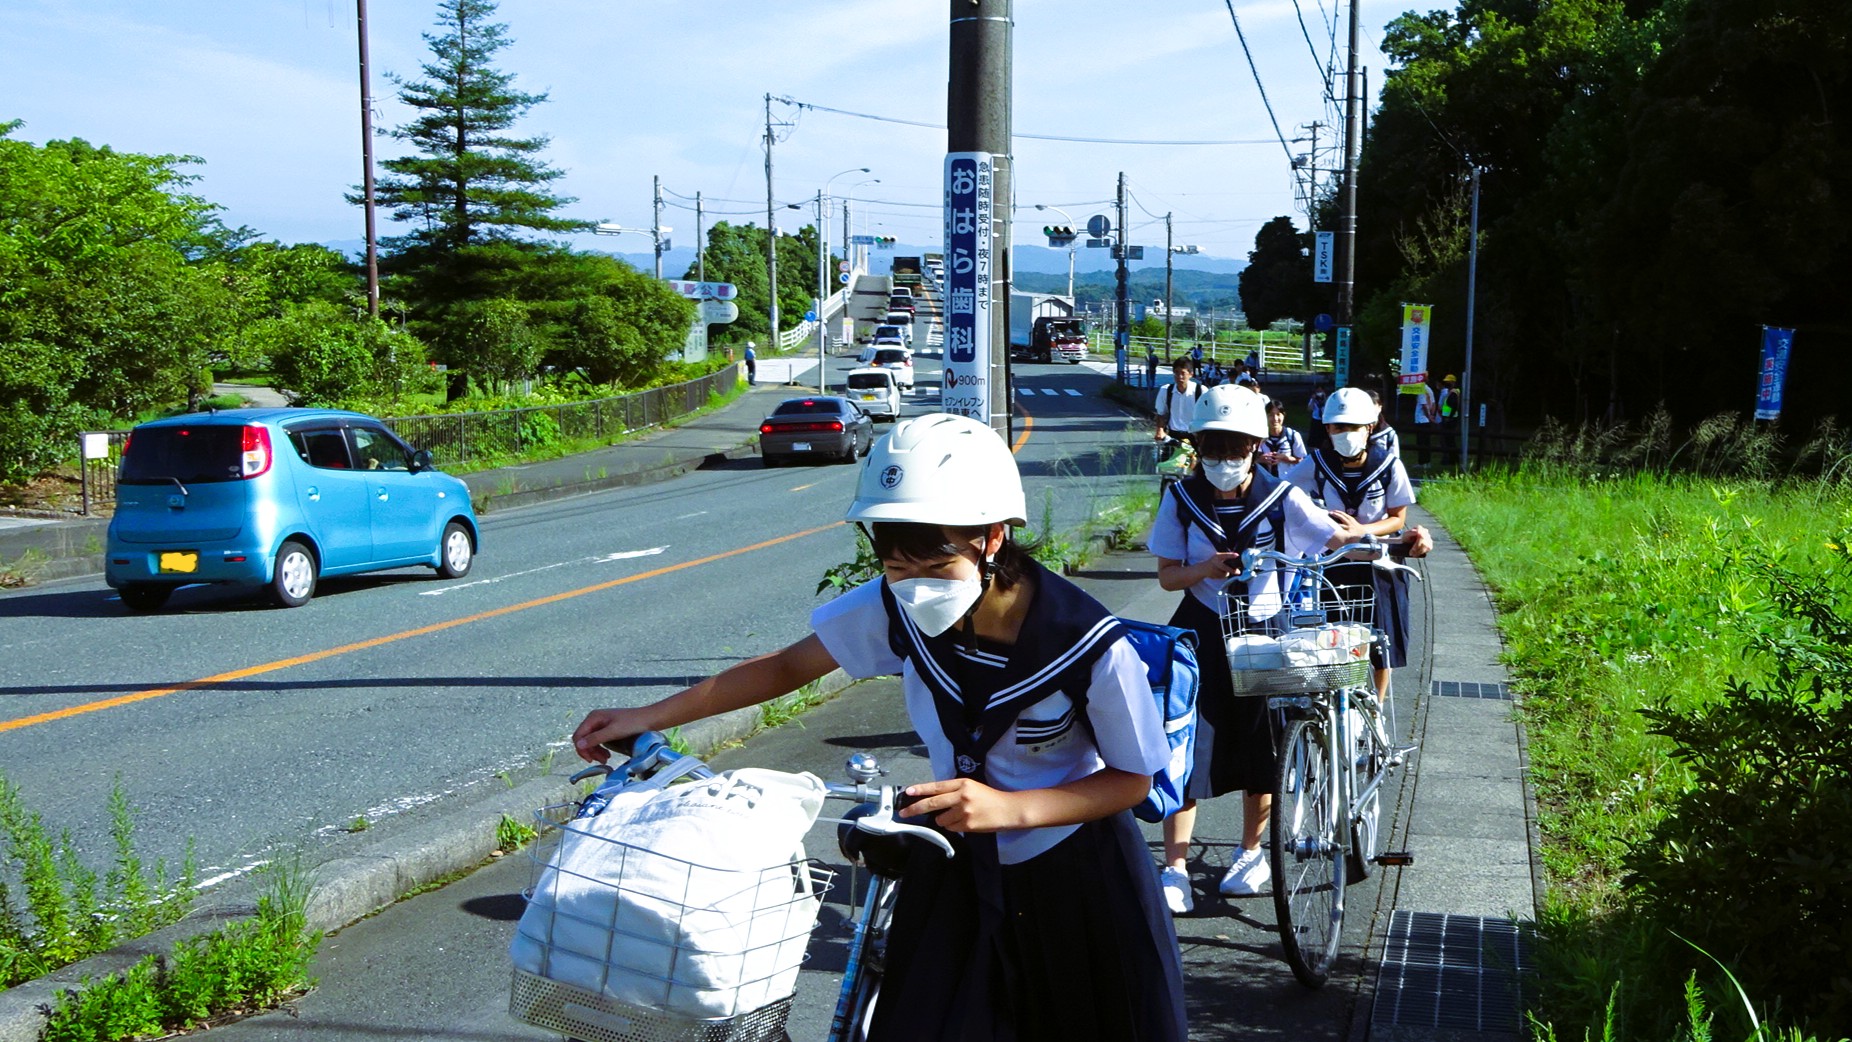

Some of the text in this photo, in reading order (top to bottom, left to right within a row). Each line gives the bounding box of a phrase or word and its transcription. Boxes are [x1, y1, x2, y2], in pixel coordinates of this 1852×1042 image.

[951, 167, 976, 354] おはら歯科
[1320, 241, 1328, 268] TSK
[958, 374, 985, 386] 900m
